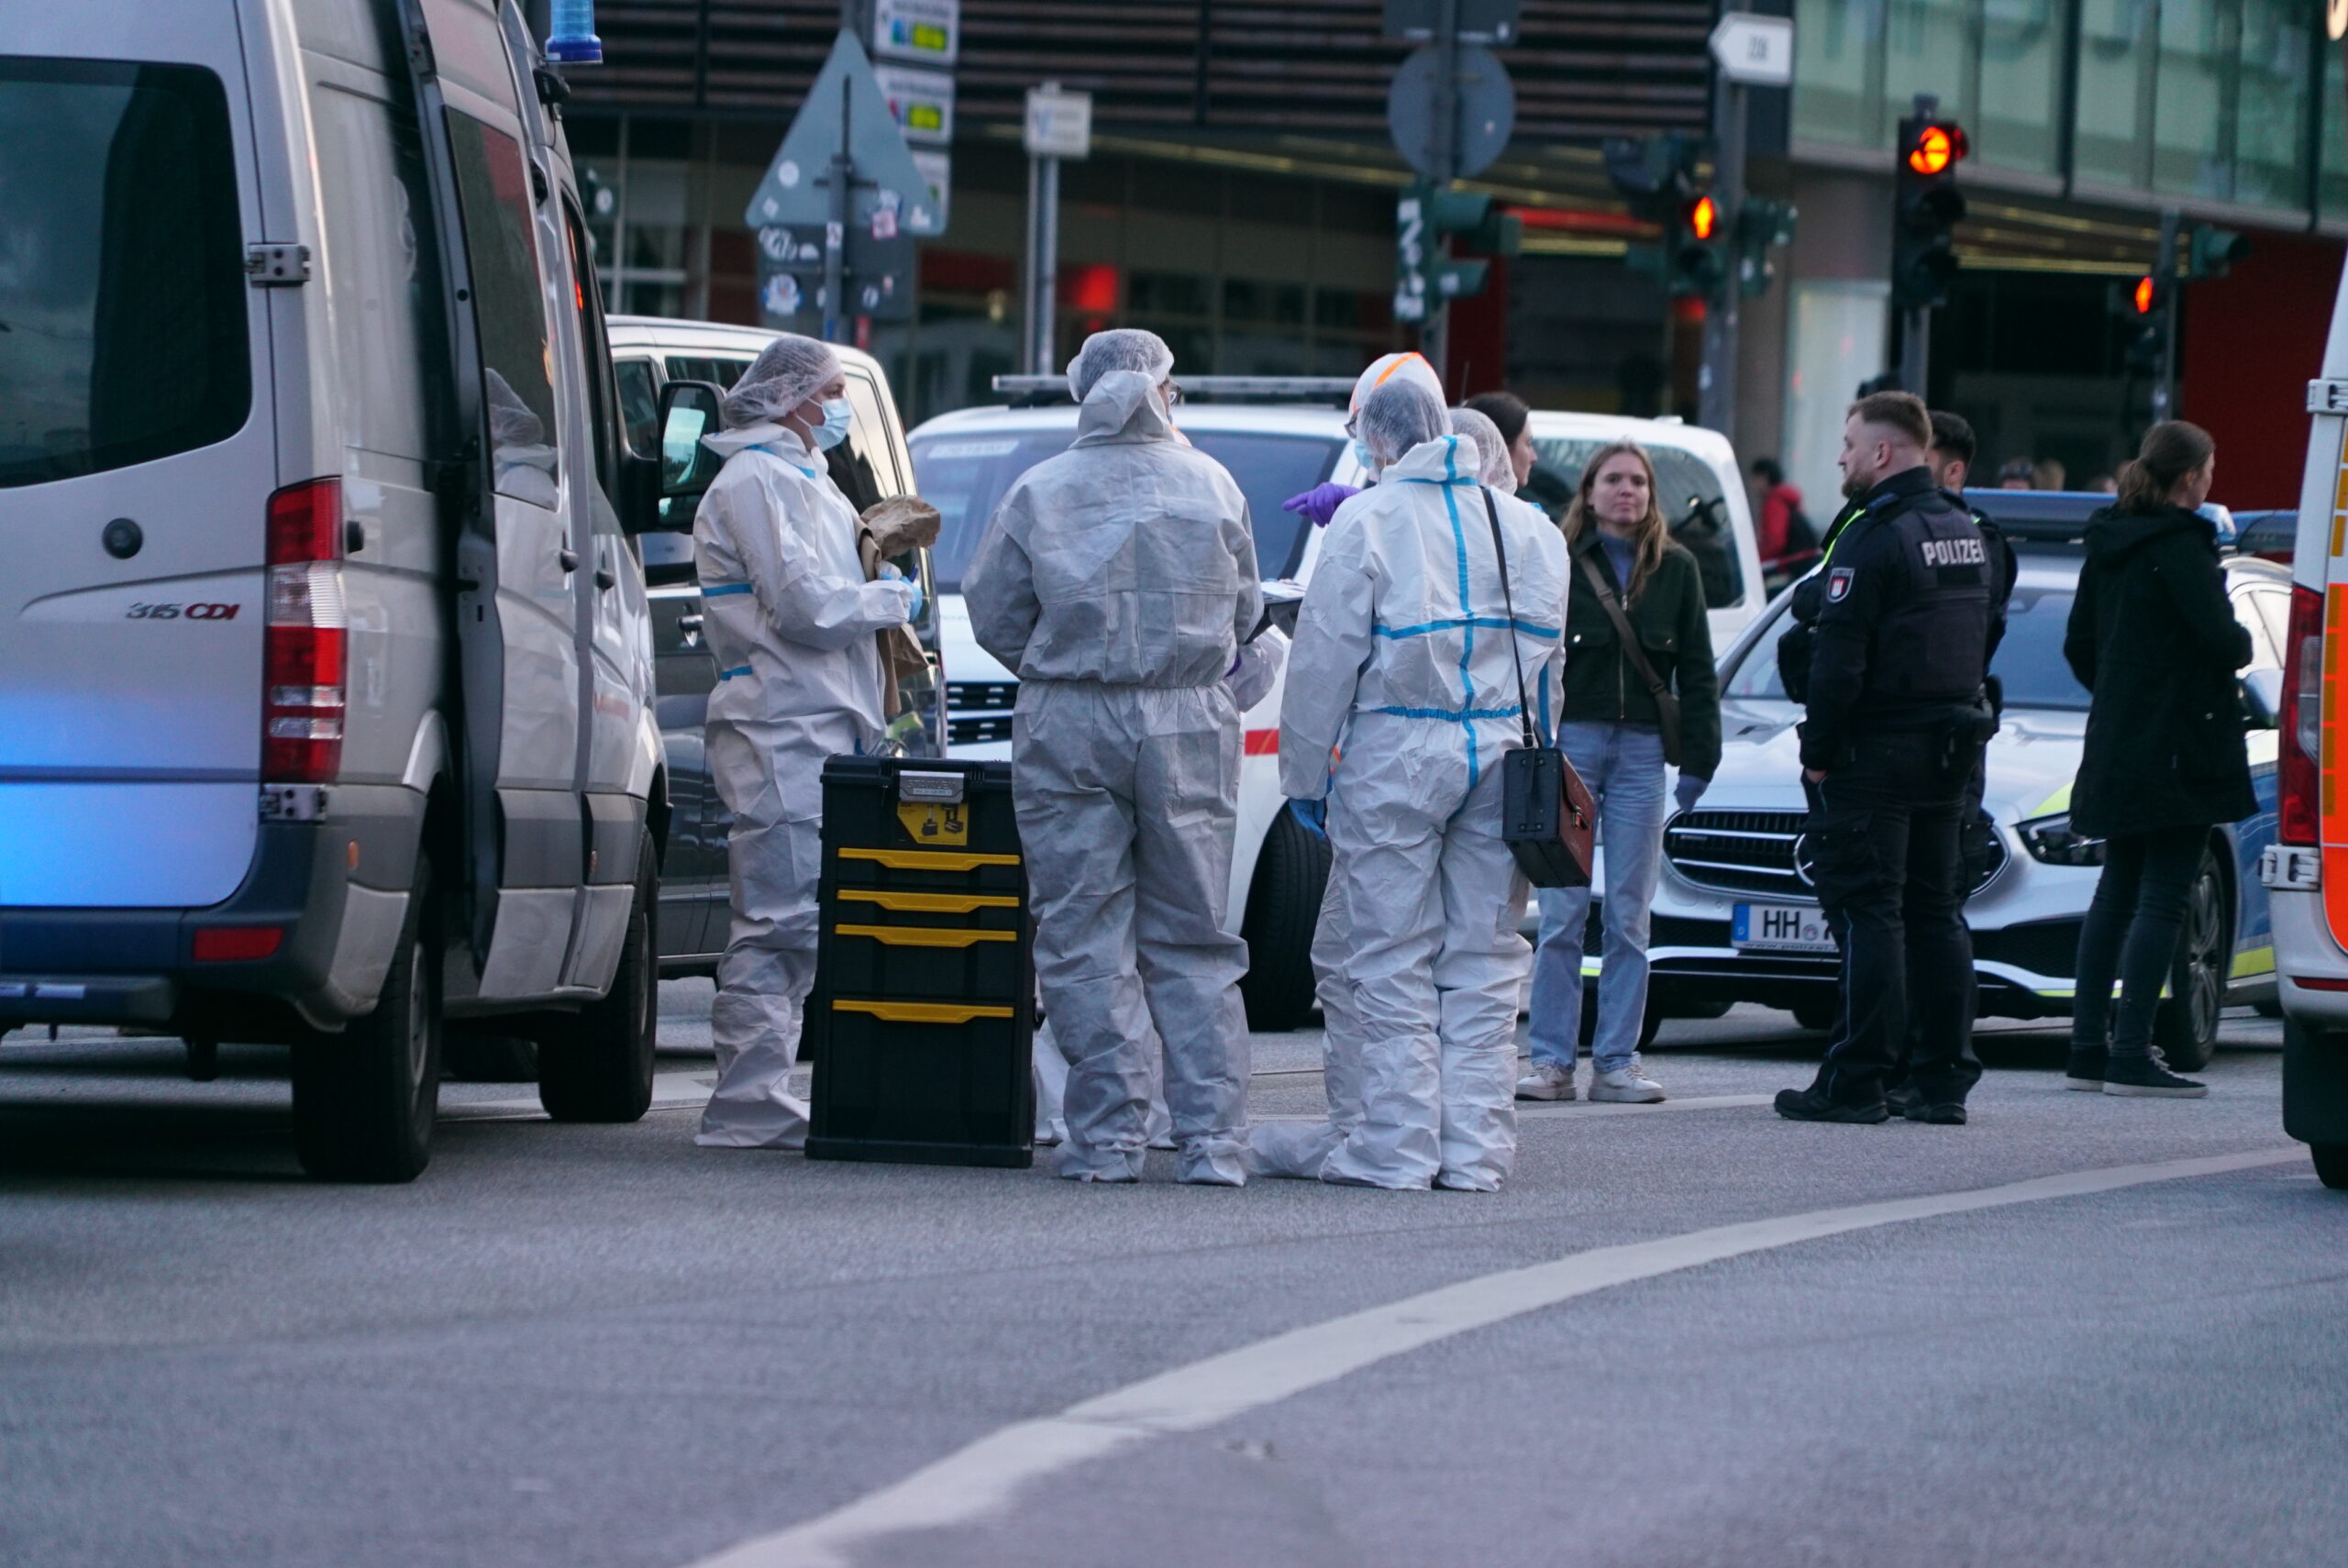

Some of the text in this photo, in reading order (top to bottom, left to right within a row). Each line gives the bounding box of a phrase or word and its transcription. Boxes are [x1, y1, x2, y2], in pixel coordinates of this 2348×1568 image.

[1922, 538, 1986, 567] POLIZEI
[126, 602, 240, 621] 315 CDI
[906, 779, 957, 790] STANLEY
[1762, 910, 1801, 939] HH
